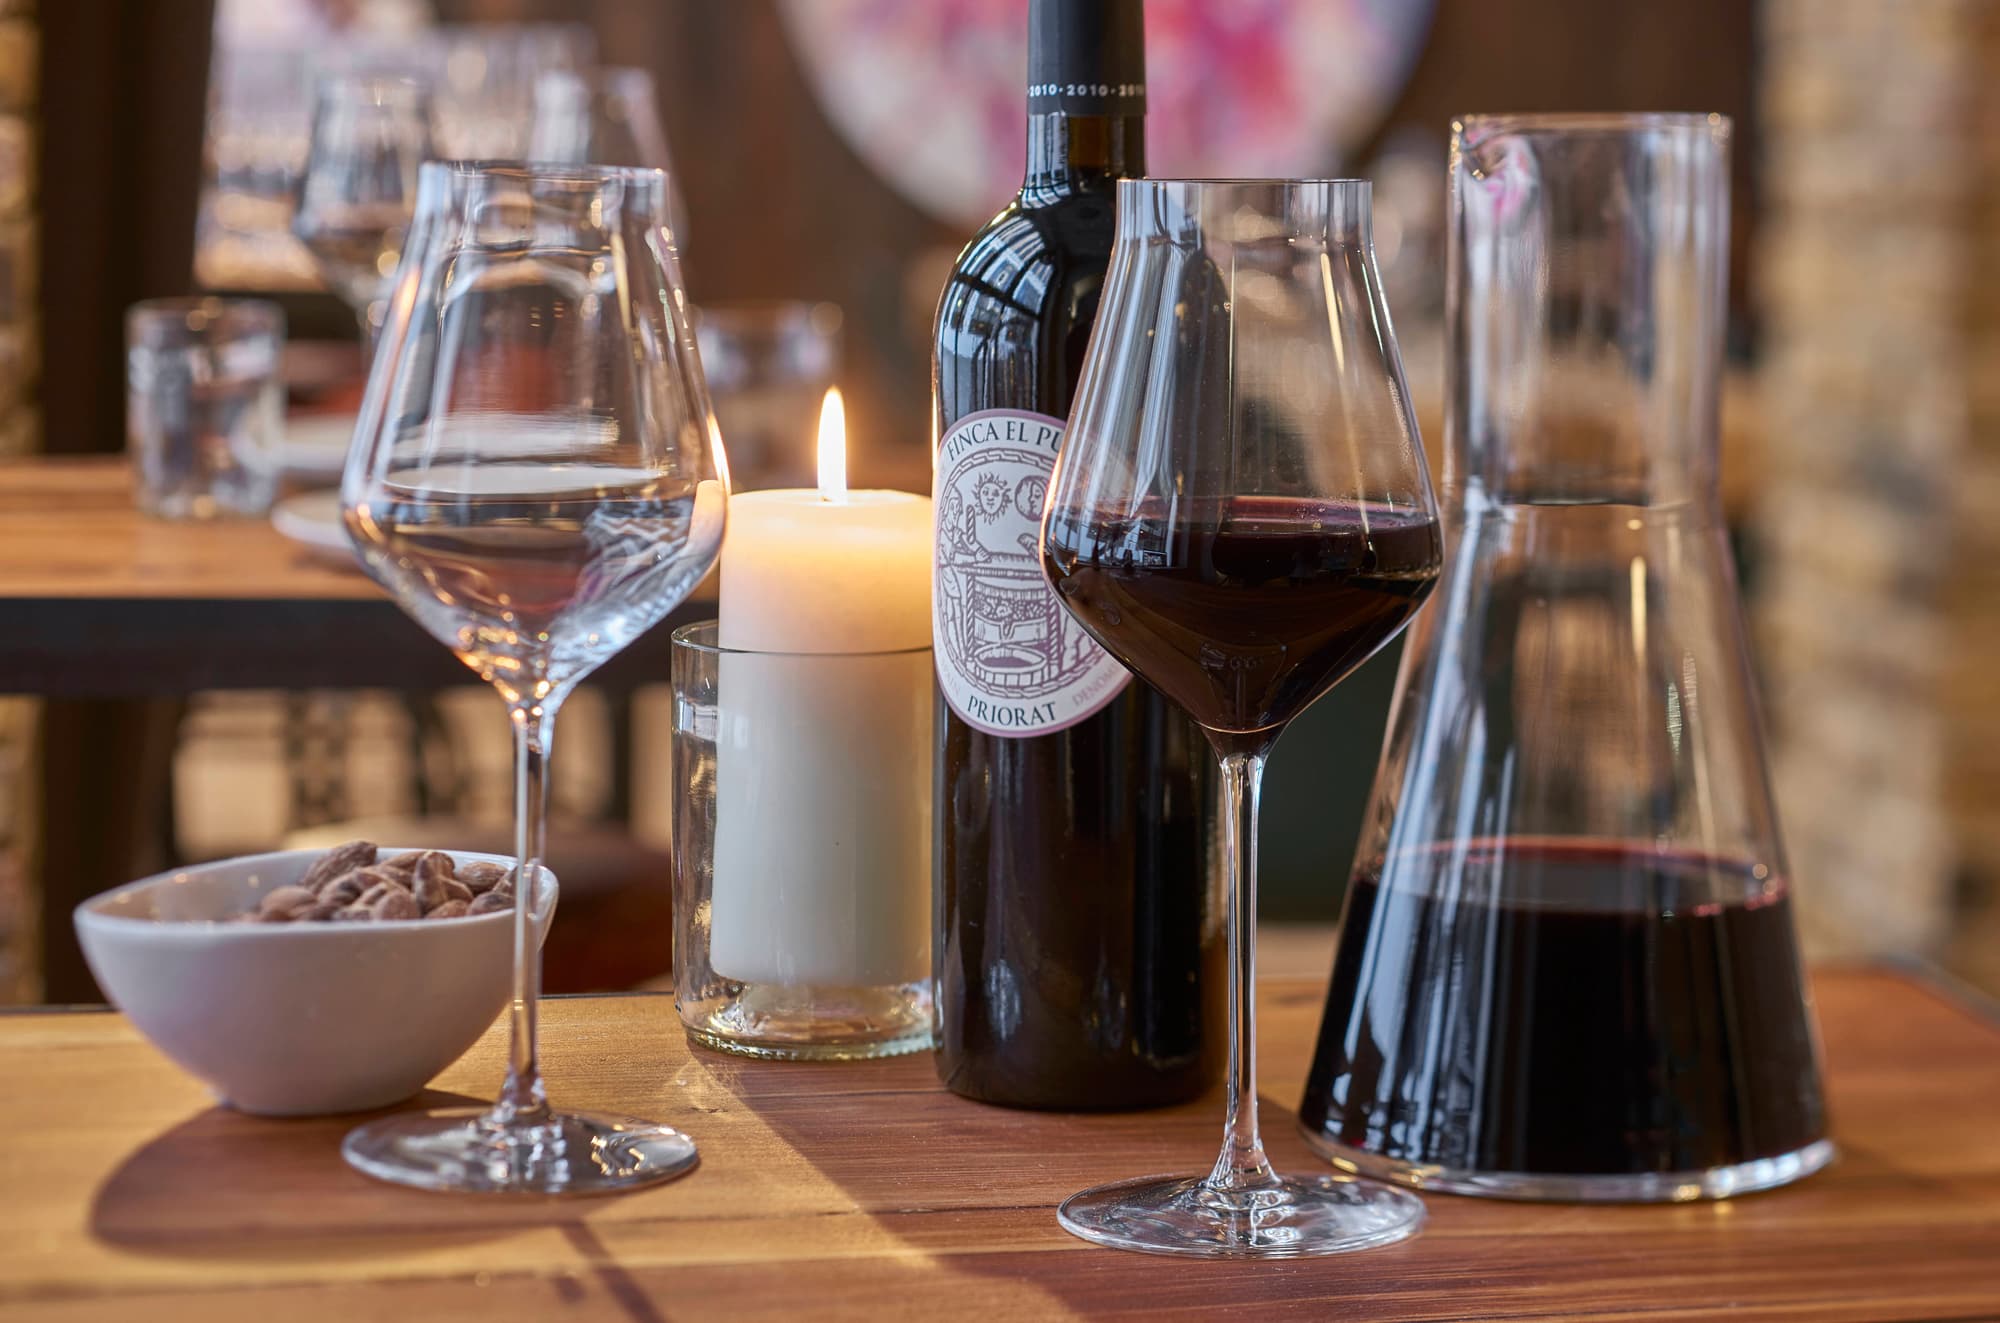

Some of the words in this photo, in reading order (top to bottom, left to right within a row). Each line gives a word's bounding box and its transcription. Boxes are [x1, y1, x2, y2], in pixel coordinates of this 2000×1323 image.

[947, 421, 999, 461] FINCA
[1007, 420, 1028, 442] EL
[967, 695, 1056, 727] PRIORAT
